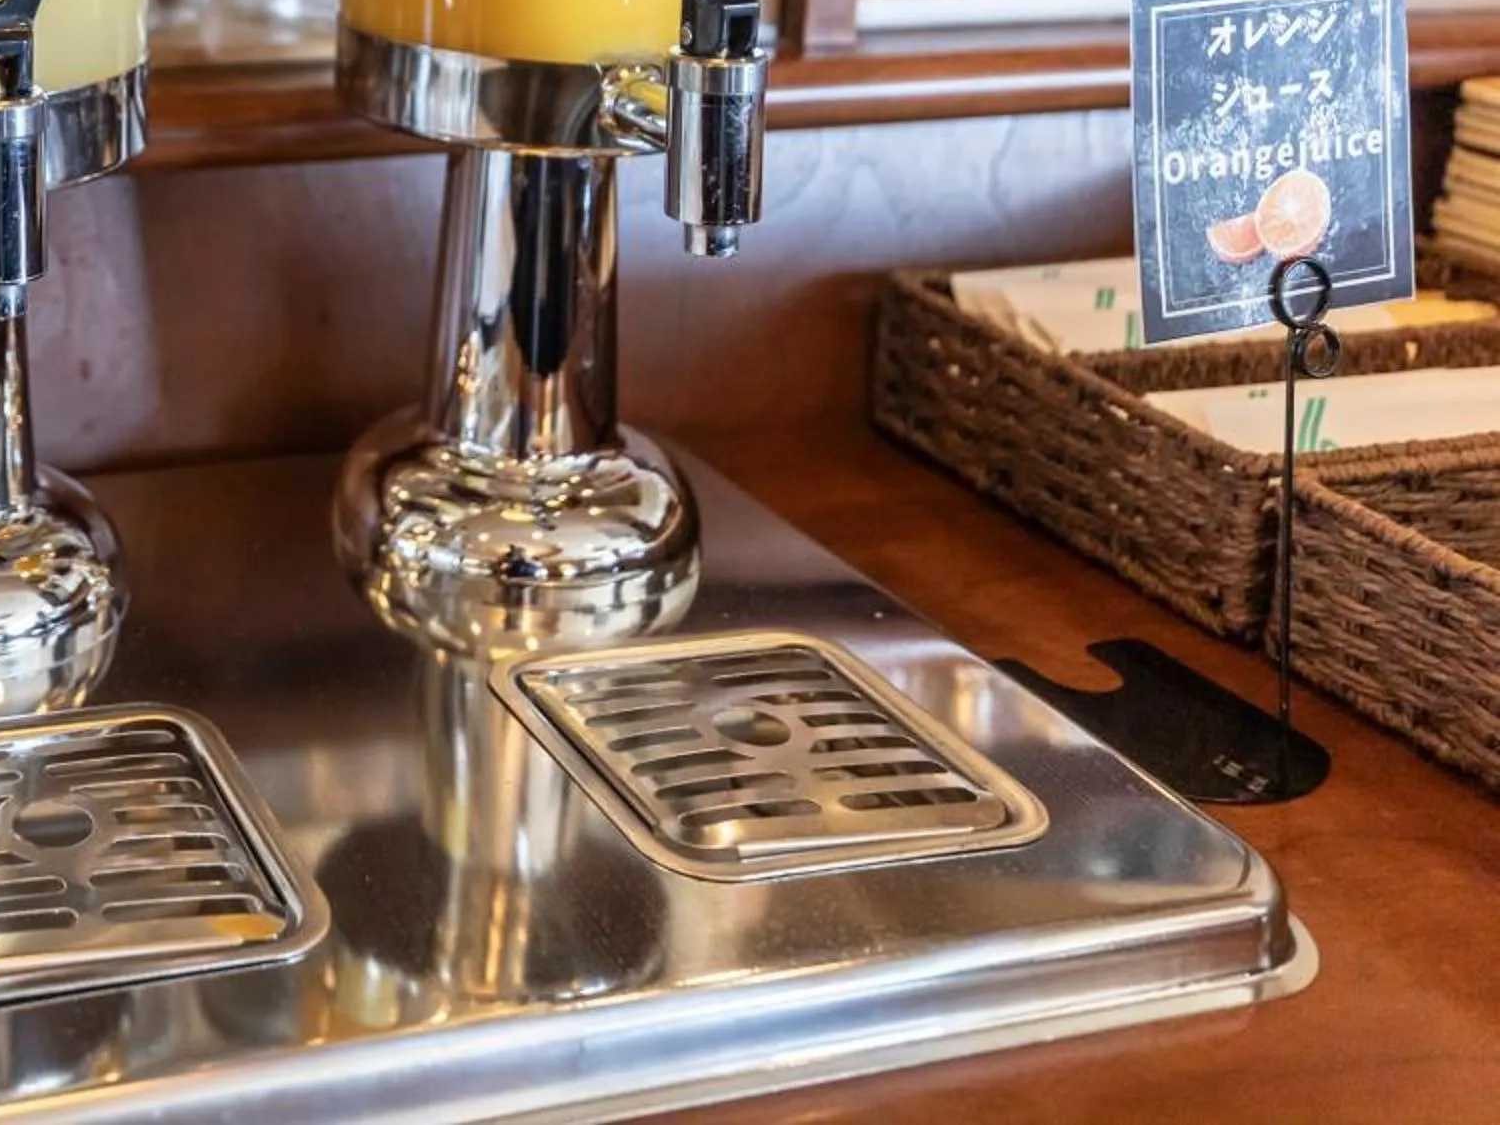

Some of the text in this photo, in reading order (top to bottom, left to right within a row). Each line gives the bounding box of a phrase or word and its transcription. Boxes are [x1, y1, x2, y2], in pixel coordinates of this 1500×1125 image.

[1208, 5, 1338, 57] オレンジ
[1212, 70, 1334, 118] ジュース
[1163, 129, 1383, 184] Orangejuice
